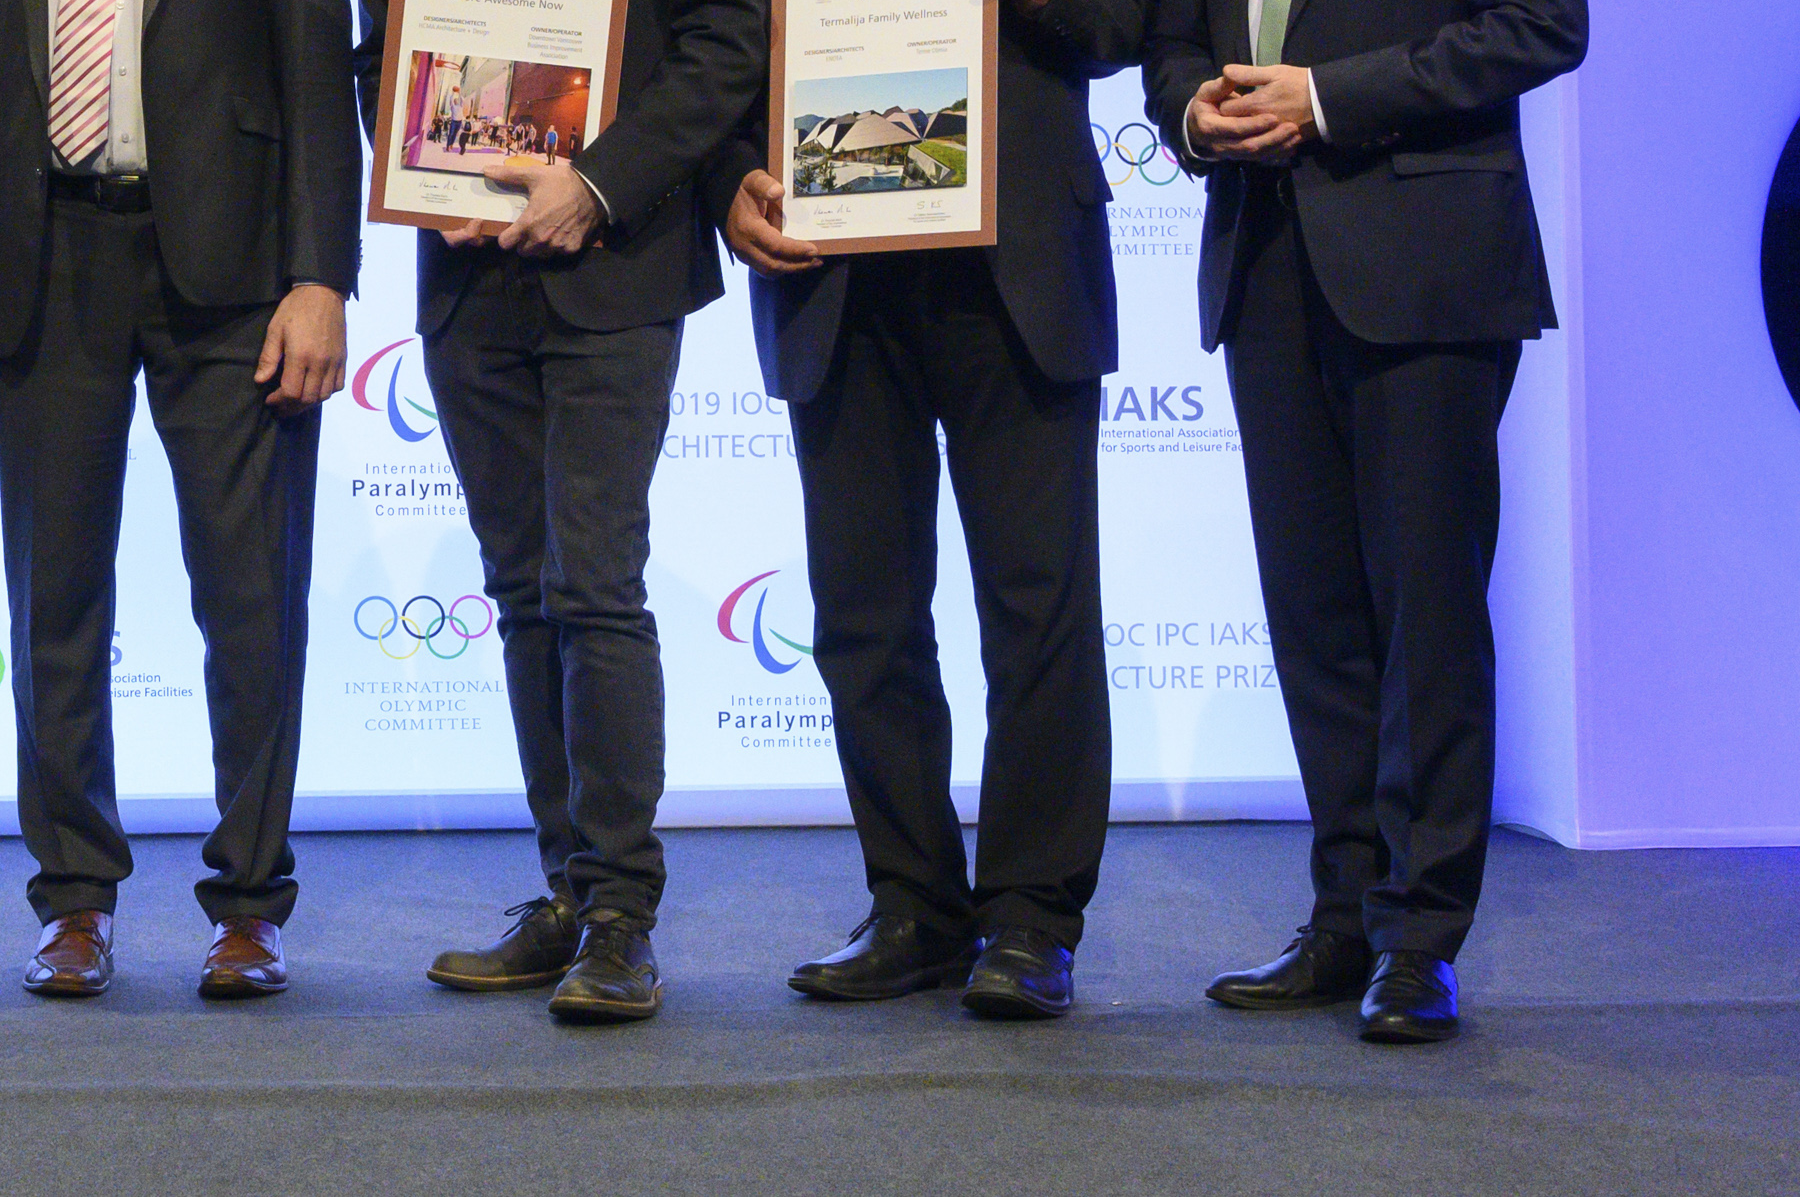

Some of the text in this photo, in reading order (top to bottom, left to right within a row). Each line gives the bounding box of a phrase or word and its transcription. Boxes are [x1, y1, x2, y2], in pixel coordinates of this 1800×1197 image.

[820, 8, 948, 29] Termalija Family Wellness
[530, 25, 583, 37] OWNER/OPERATOR
[907, 37, 957, 48] OWNER/OPERATOR
[1107, 207, 1204, 219] RNATIONA
[1110, 225, 1179, 237] LYMPIC
[1112, 243, 1194, 256] MMITTEE
[670, 391, 720, 415] 019
[1101, 385, 1204, 421] IAKS
[1101, 427, 1174, 439] International
[1101, 441, 1223, 455] for Sports and Leisure
[365, 462, 452, 474] Internatio
[352, 479, 465, 500] Paralymp
[375, 504, 467, 516] Committee
[1104, 623, 1145, 646] OC
[1156, 622, 1199, 646] IPC
[1216, 664, 1276, 688] PRIZ
[144, 686, 193, 697] Facilities
[345, 680, 504, 695] INTERNATIONAL
[380, 699, 466, 712] OLYMPIC
[731, 694, 827, 706] Internation
[365, 718, 481, 731] COMMITTEE
[718, 710, 833, 732] Paralymp
[741, 736, 832, 748] Committee
